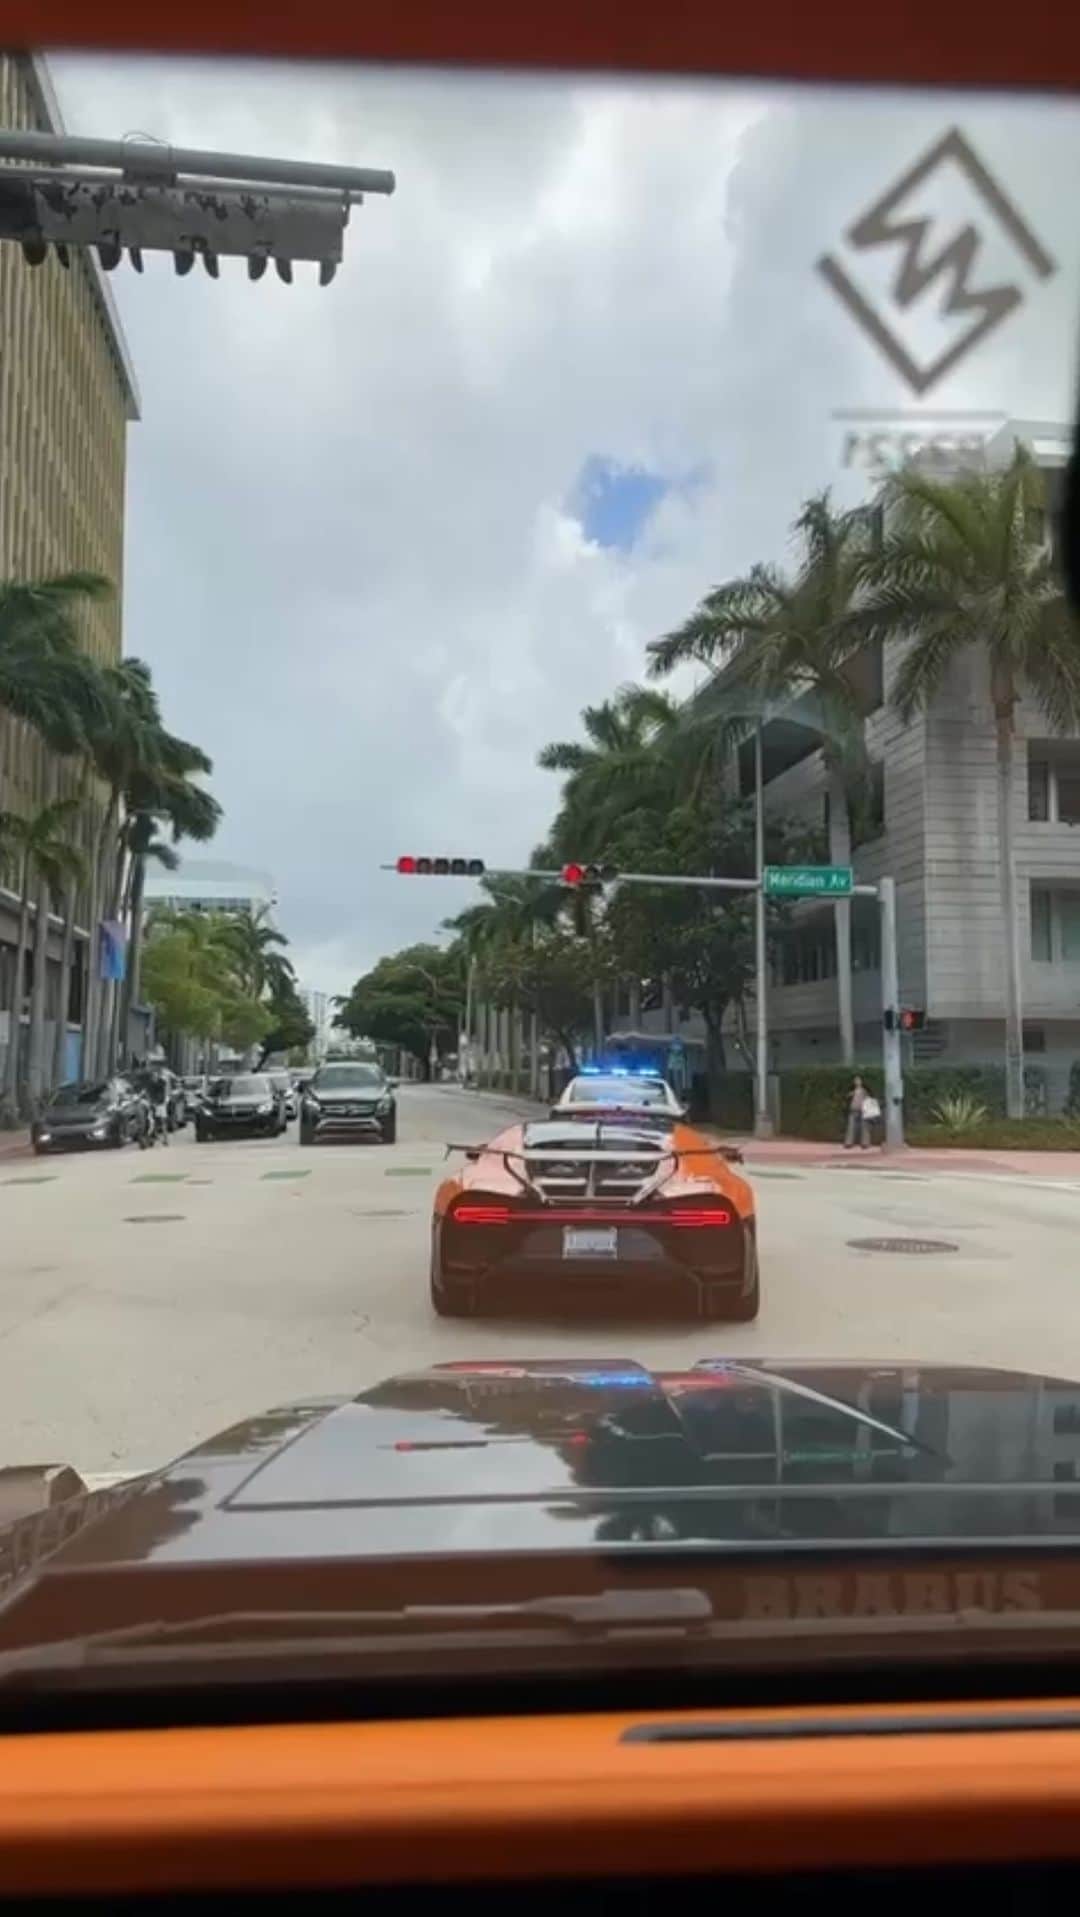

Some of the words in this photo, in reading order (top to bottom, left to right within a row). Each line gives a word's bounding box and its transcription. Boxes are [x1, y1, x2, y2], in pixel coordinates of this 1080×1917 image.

[769, 871, 826, 888] Meridian
[830, 872, 848, 888] Av
[743, 1571, 1041, 1620] BRABUS
